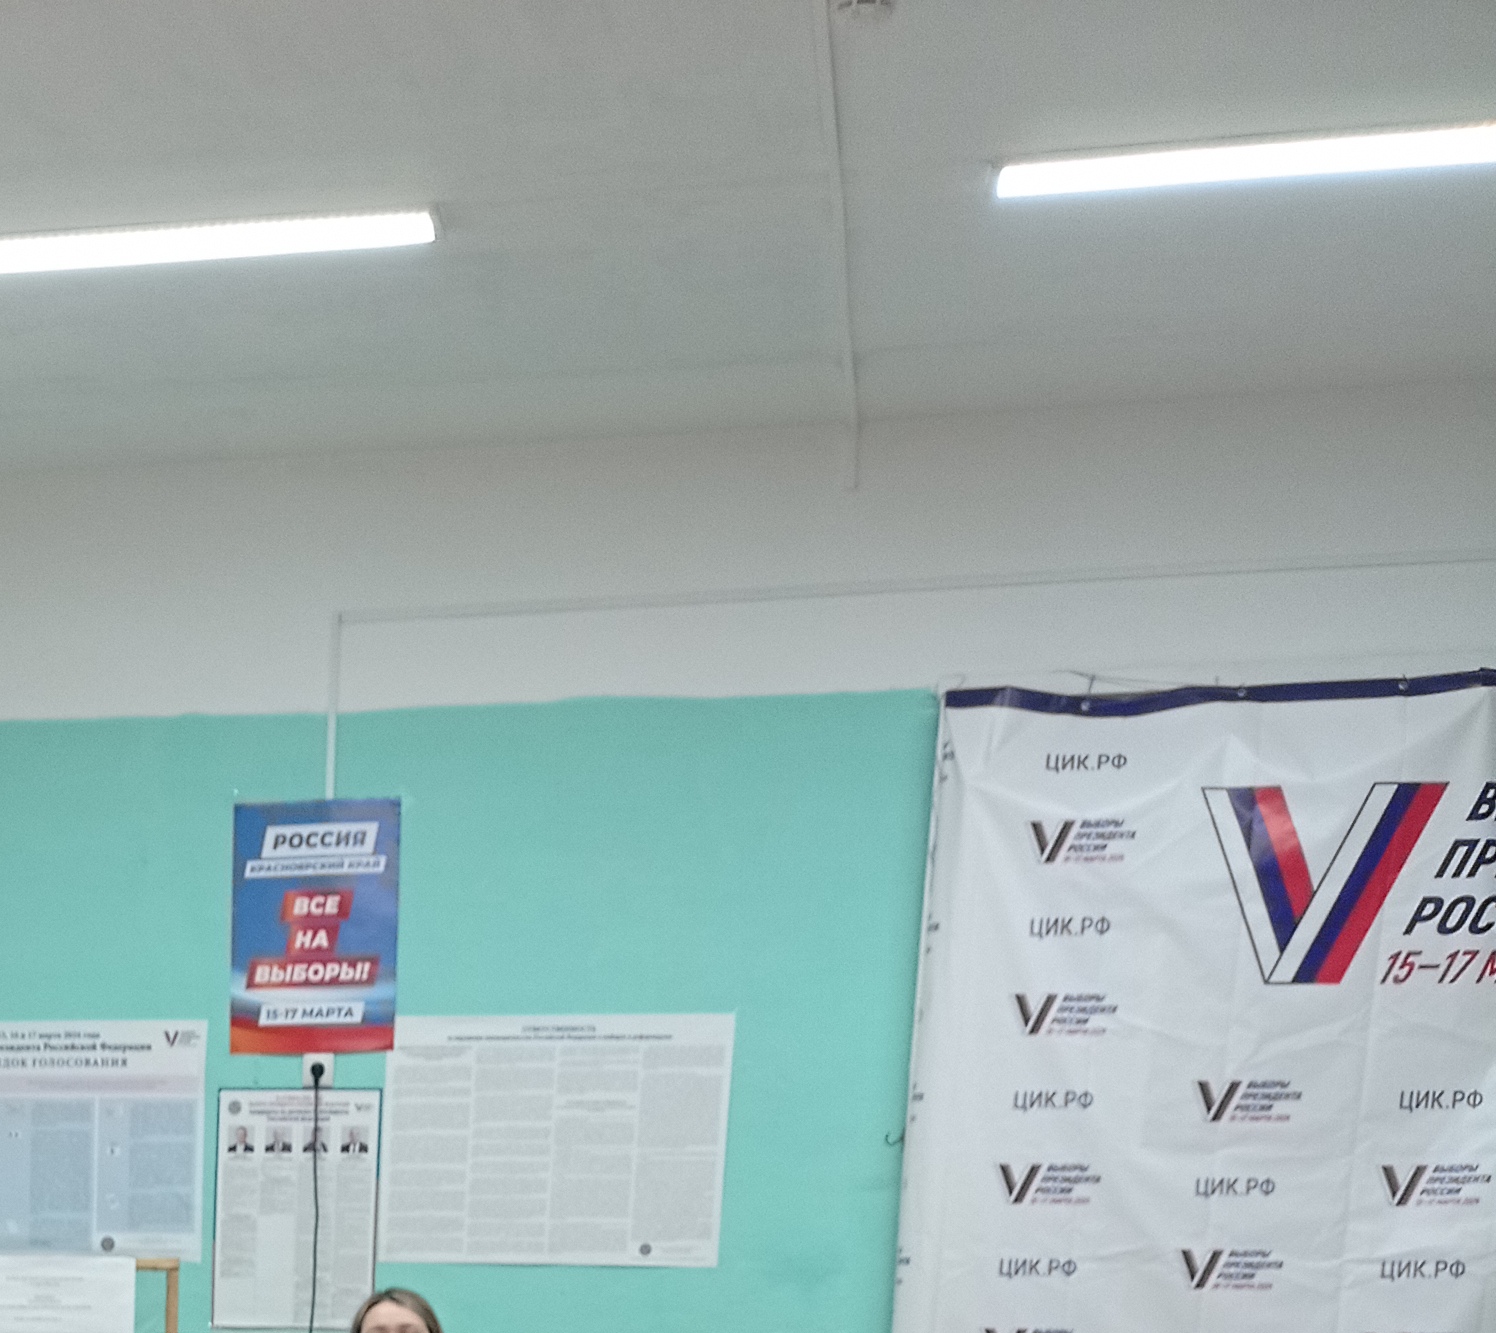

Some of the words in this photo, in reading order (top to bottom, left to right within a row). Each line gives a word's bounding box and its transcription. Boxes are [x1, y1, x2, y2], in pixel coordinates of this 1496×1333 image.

[1045, 752, 1128, 774] ЦИК.РФ
[273, 830, 368, 850] РОССИЯ
[293, 894, 341, 916] ВСЕ
[1403, 895, 1496, 937] РОС
[1029, 916, 1111, 939] ЦИК.РФ
[294, 929, 329, 950] НА
[255, 962, 372, 984] ВЫБОРЫ!
[266, 1007, 298, 1021] 15-17
[302, 1006, 354, 1020] МАРТА
[32, 1057, 128, 1068] ГОЛОСОВАНИЯ
[1012, 1090, 1094, 1112] ЦИК.РФ
[1398, 1090, 1484, 1113] ЦИК.РФ
[1194, 1177, 1276, 1199] ЦИК.РФ
[999, 1258, 1078, 1279] ЦИК.РФ
[1379, 1259, 1466, 1281] ЦИК.РФ
